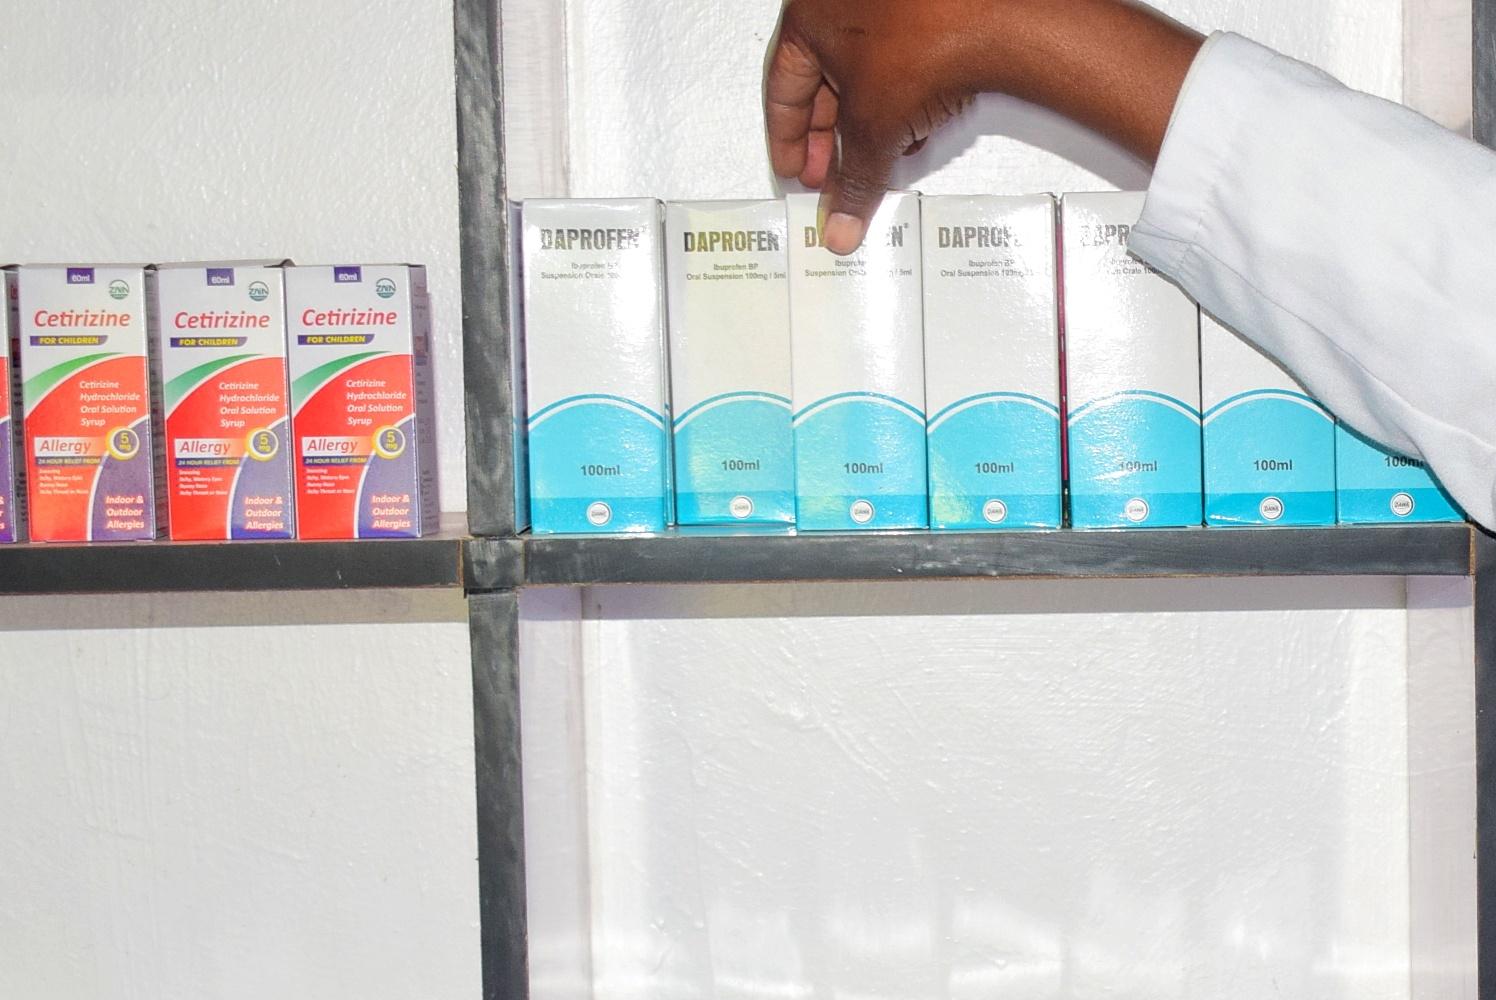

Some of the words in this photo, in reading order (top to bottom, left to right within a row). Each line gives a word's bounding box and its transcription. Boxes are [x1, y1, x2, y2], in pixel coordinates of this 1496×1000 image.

[713, 263, 747, 271] Ibuprofen
[703, 273, 743, 281] Suspension
[745, 272, 768, 281] 100mg
[34, 309, 130, 327] Cetirizine
[175, 311, 270, 329] Cetirizine
[302, 308, 397, 327] Cetirizine
[198, 338, 238, 346] CHILDREN
[307, 336, 324, 344] FOR
[326, 335, 366, 343] CHILDREN
[346, 380, 386, 388] Cetirizine
[347, 392, 407, 400] Hydrochloride
[347, 404, 366, 412] Oral
[368, 404, 403, 412] Solution
[347, 416, 372, 426] Syrup
[387, 432, 395, 442] 5
[39, 440, 92, 454] Allergy
[180, 440, 230, 454] Allergy
[307, 439, 358, 453] Allergy
[721, 460, 760, 471] 100ml
[1254, 459, 1292, 471] 100ml
[1385, 456, 1424, 468] 100m
[581, 465, 620, 476] 100ml
[844, 463, 883, 474] 100ml
[975, 462, 1014, 474] 100ml
[245, 496, 273, 504] Indoor
[275, 496, 283, 504] &
[246, 508, 282, 517] Outdoor
[246, 521, 284, 530] Allergies
